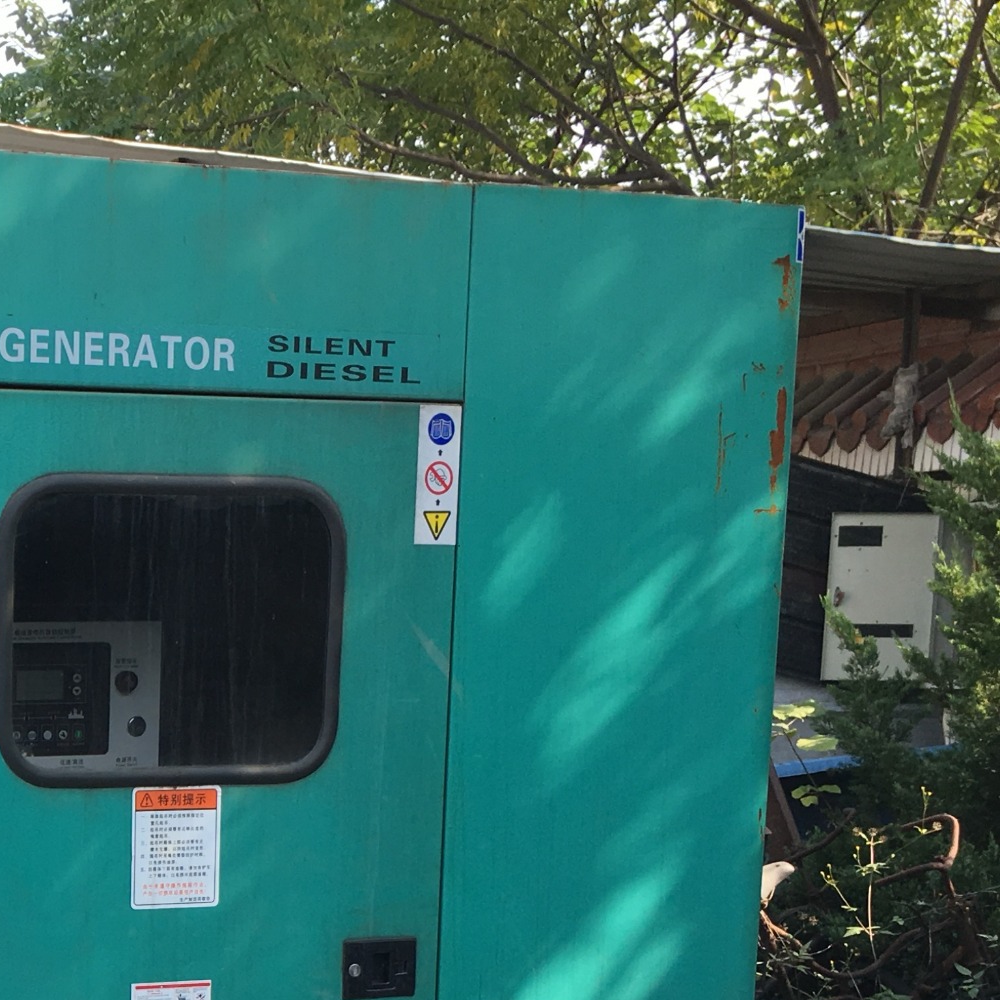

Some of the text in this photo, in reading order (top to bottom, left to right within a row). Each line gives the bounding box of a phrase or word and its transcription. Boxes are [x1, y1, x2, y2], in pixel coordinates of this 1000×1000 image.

[0, 327, 235, 372] GENERATOR
[267, 334, 396, 357] SILENT
[266, 360, 421, 384] DIESEL
[157, 793, 207, 806] 特别提示
